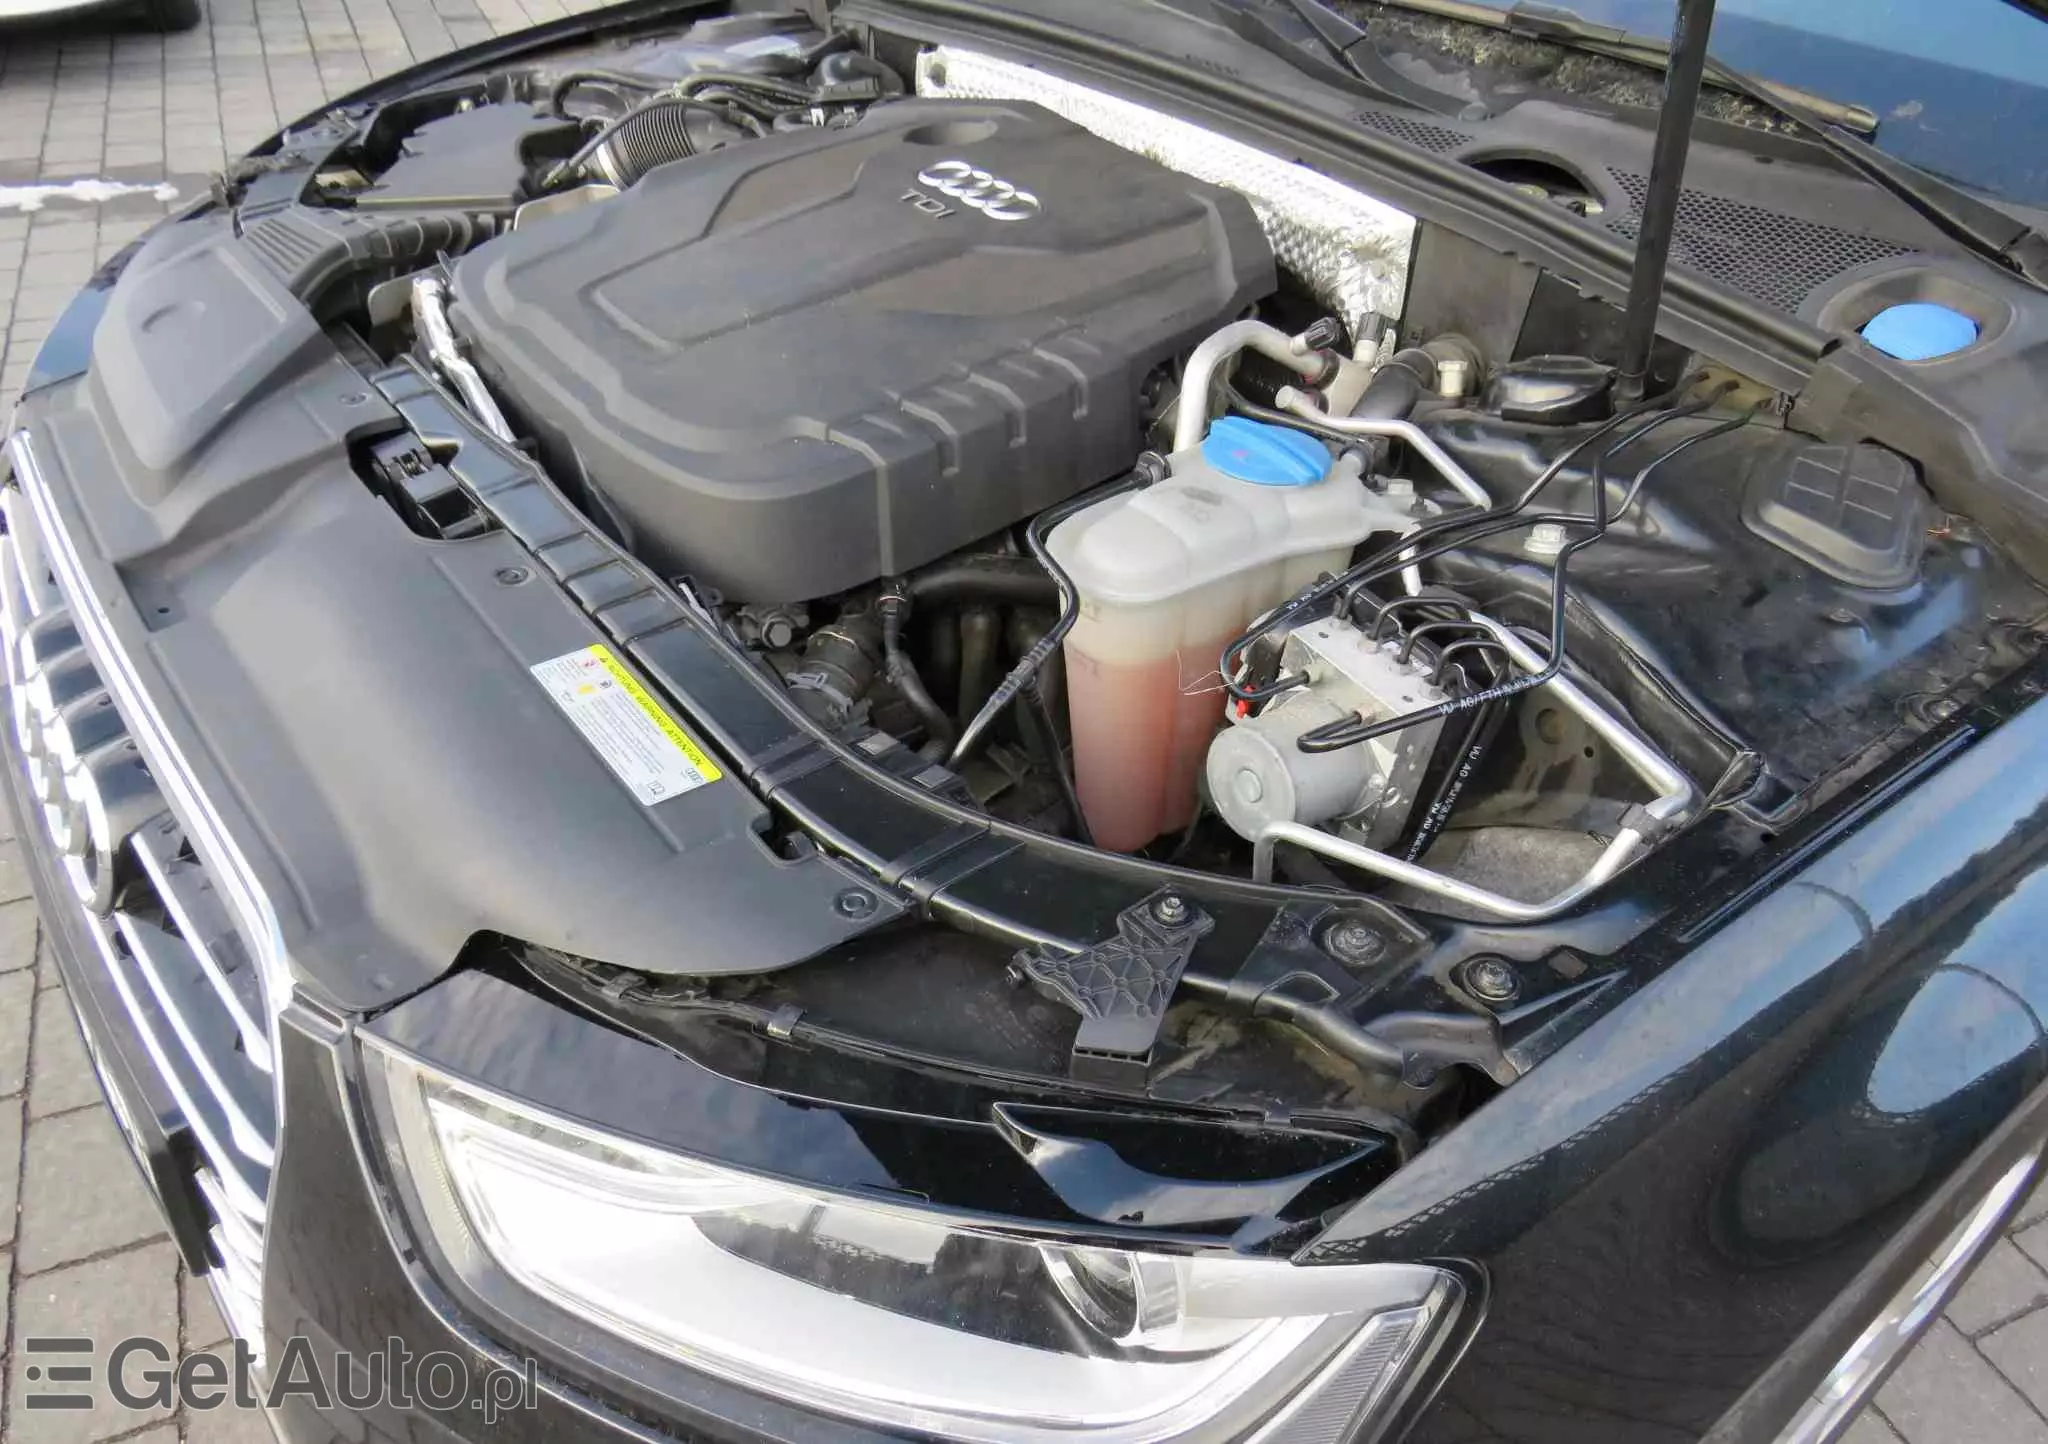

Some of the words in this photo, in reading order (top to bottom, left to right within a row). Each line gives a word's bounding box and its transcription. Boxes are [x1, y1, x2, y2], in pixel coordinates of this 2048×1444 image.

[900, 189, 956, 219] TDI
[666, 728, 703, 766] ATTENTION
[1459, 763, 1472, 777] AG
